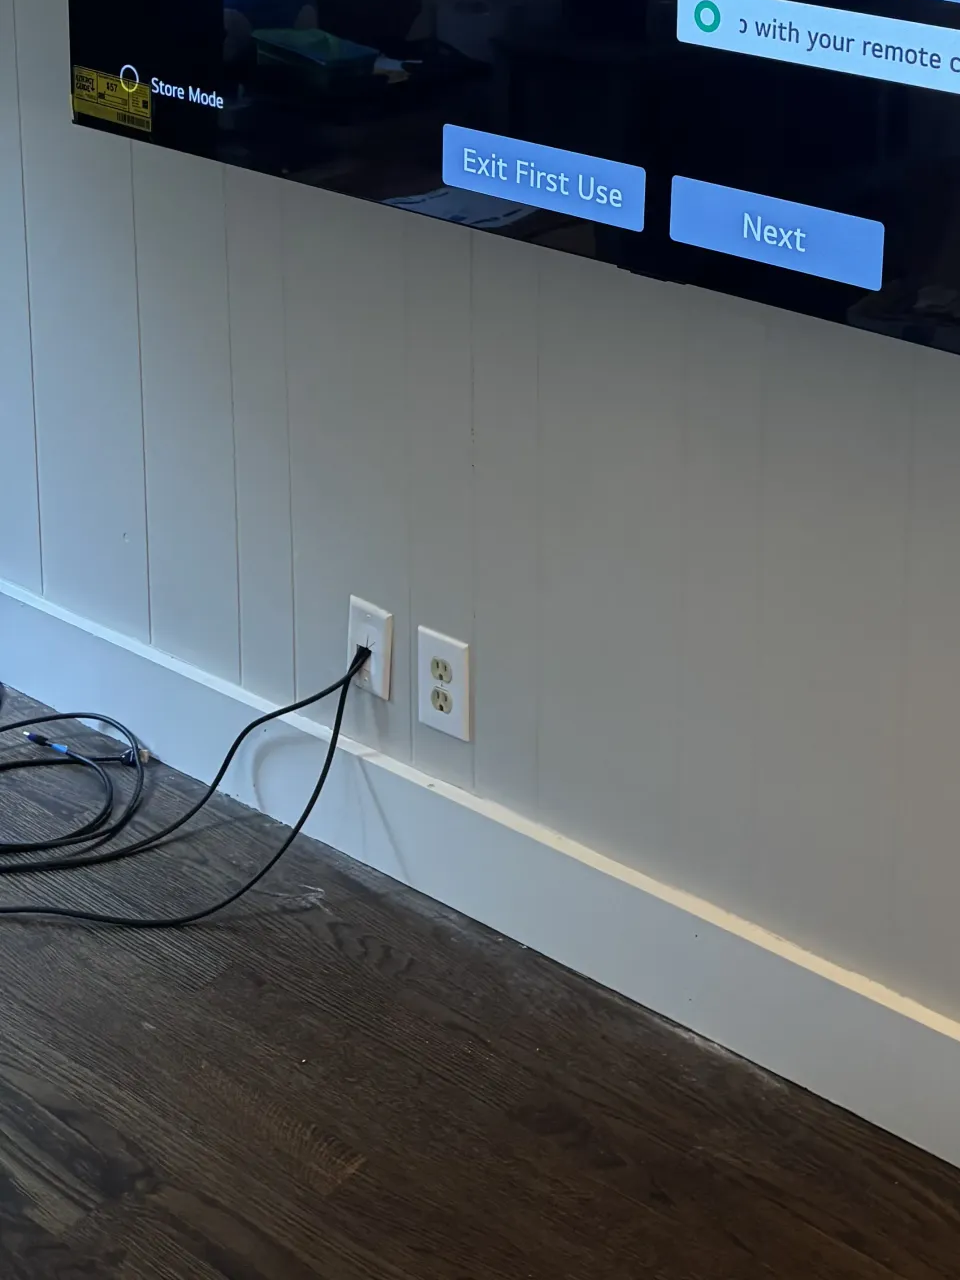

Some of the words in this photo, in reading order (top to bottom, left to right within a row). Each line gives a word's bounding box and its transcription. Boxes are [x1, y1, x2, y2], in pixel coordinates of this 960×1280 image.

[755, 18, 800, 44] with
[806, 28, 855, 53] your
[862, 39, 942, 70] remote
[151, 77, 185, 100] Store
[188, 85, 224, 109] Mode
[463, 148, 508, 182] Exit
[515, 160, 570, 196] First
[578, 176, 624, 208] Use
[743, 212, 807, 253] Next
